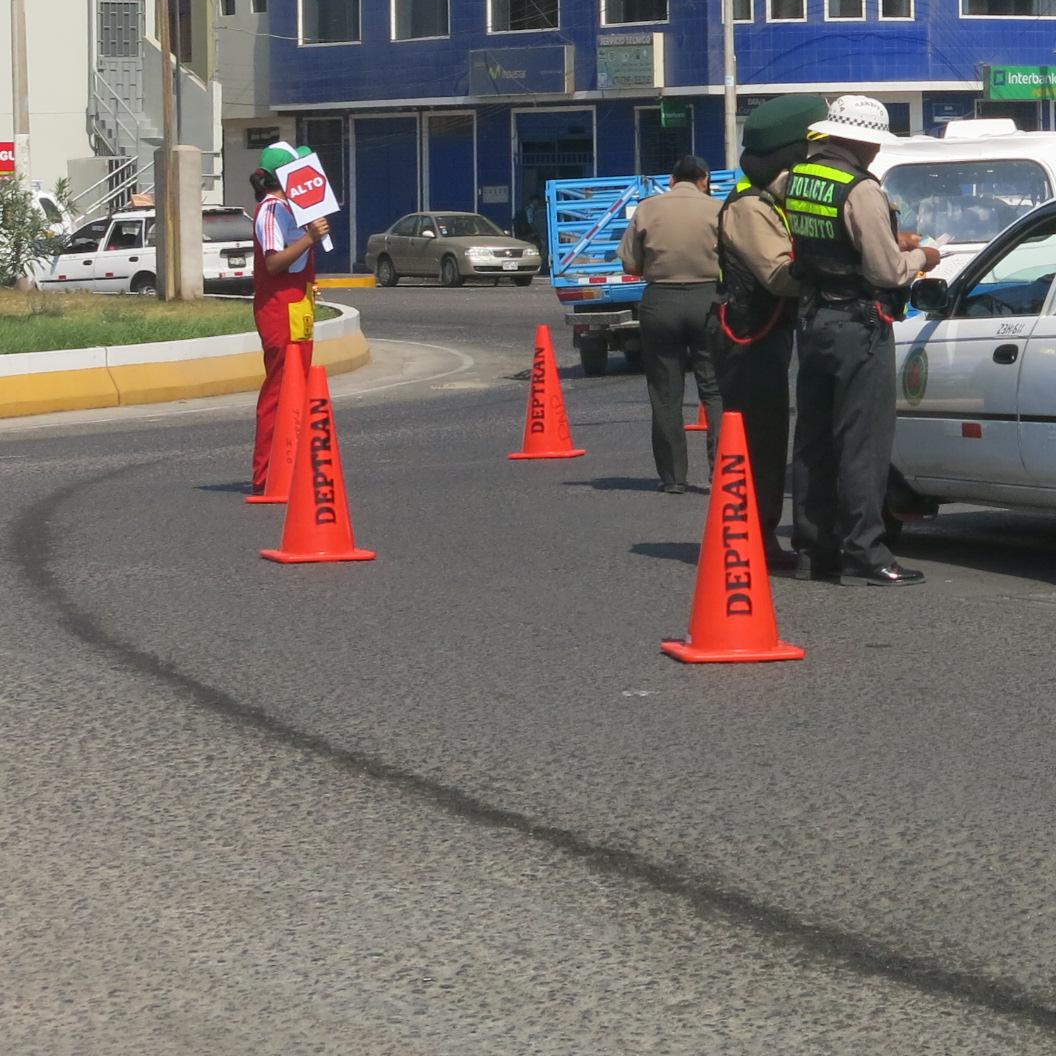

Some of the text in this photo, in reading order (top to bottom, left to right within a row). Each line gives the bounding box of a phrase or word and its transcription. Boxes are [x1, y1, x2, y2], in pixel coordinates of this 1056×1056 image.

[290, 176, 323, 198] ALTO
[530, 346, 546, 435] DEPTRAN
[308, 397, 337, 526] DEPTRAN
[720, 453, 753, 617] DEPTRAN
